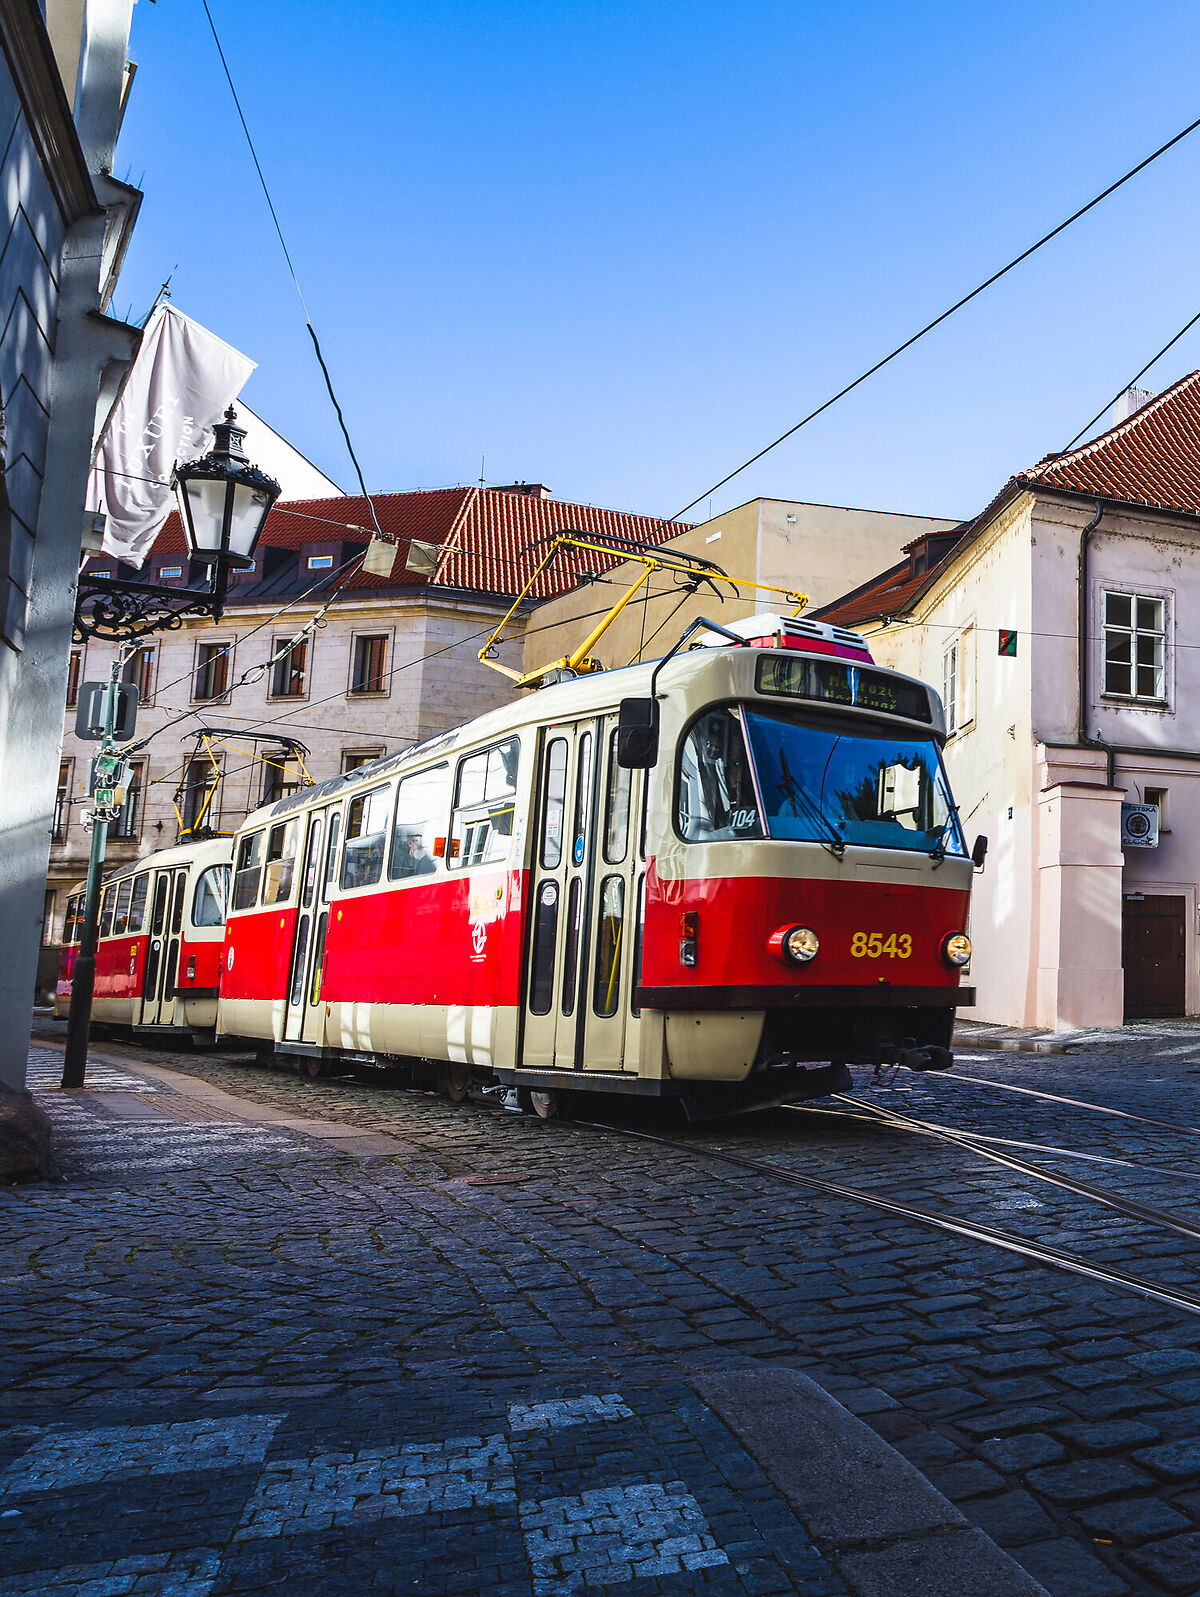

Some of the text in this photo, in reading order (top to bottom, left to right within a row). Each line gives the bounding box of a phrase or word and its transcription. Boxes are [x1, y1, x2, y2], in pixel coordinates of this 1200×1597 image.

[116, 397, 180, 491] LUXURY
[149, 416, 194, 489] COCTION
[731, 809, 756, 828] 104
[850, 931, 912, 959] 8543
